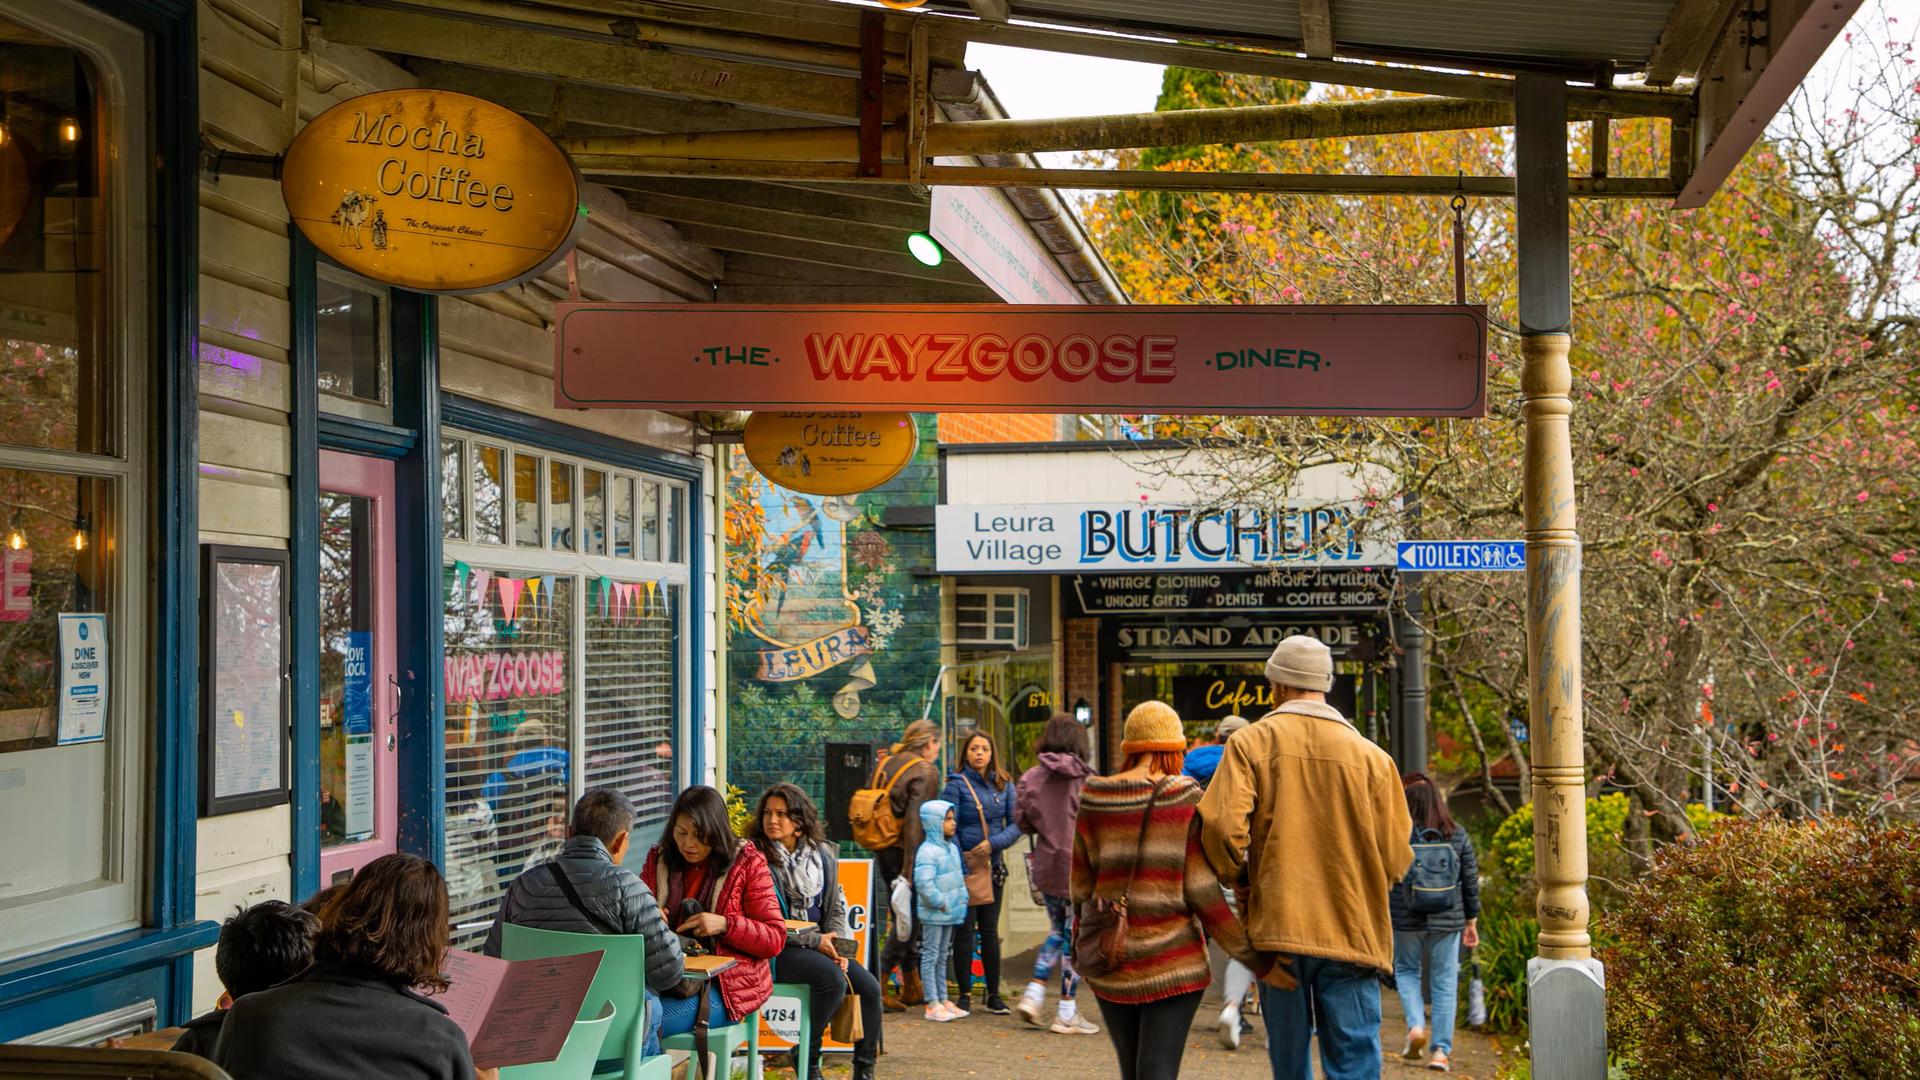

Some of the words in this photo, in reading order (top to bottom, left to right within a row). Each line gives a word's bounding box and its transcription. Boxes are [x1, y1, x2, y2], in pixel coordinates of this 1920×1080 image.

[346, 111, 485, 159] Mocha
[376, 157, 515, 212] Coffee
[804, 332, 1178, 384] WAYZGOOSE
[801, 423, 881, 447] Coffee
[974, 512, 1055, 532] Leura
[1079, 508, 1364, 563] BUTCHERY
[966, 539, 1062, 565] Village
[1417, 544, 1481, 567] TOILETS
[1100, 576, 1152, 589] VINTAGE
[1156, 575, 1222, 588] CLOTHING
[1105, 595, 1149, 608] UNIQUE
[1153, 594, 1189, 607] GIFTS
[1216, 593, 1264, 606] DENTIST
[1286, 592, 1337, 605] COFFEE
[1340, 592, 1375, 604] SHOP
[1118, 628, 1232, 647] STRAND
[74, 648, 96, 660] DINE
[766, 628, 870, 679] LEURA
[344, 662, 367, 676] LOCAL
[443, 651, 564, 703] WAYZGOOSE
[762, 1009, 796, 1021] 4784
